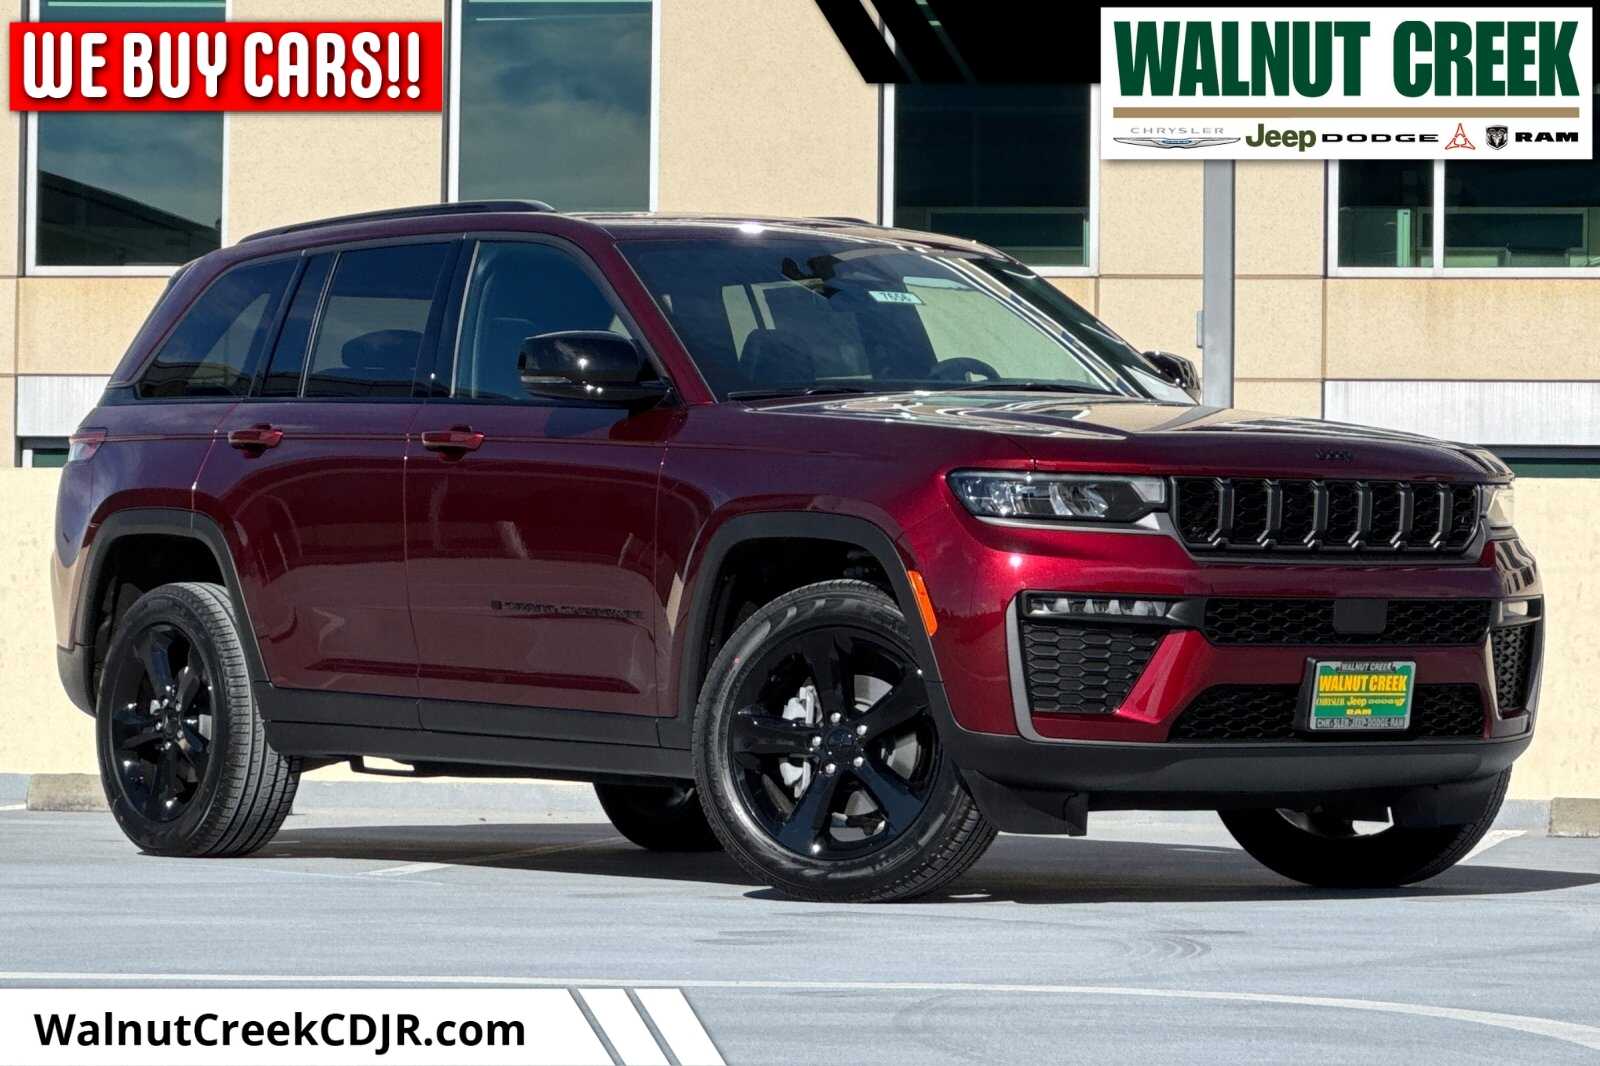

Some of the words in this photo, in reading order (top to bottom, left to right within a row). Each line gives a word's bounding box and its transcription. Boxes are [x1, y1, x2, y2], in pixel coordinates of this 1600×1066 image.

[1320, 675, 1368, 692] WALNUT
[1369, 675, 1408, 691] CREEK
[1347, 696, 1367, 707] Jeep
